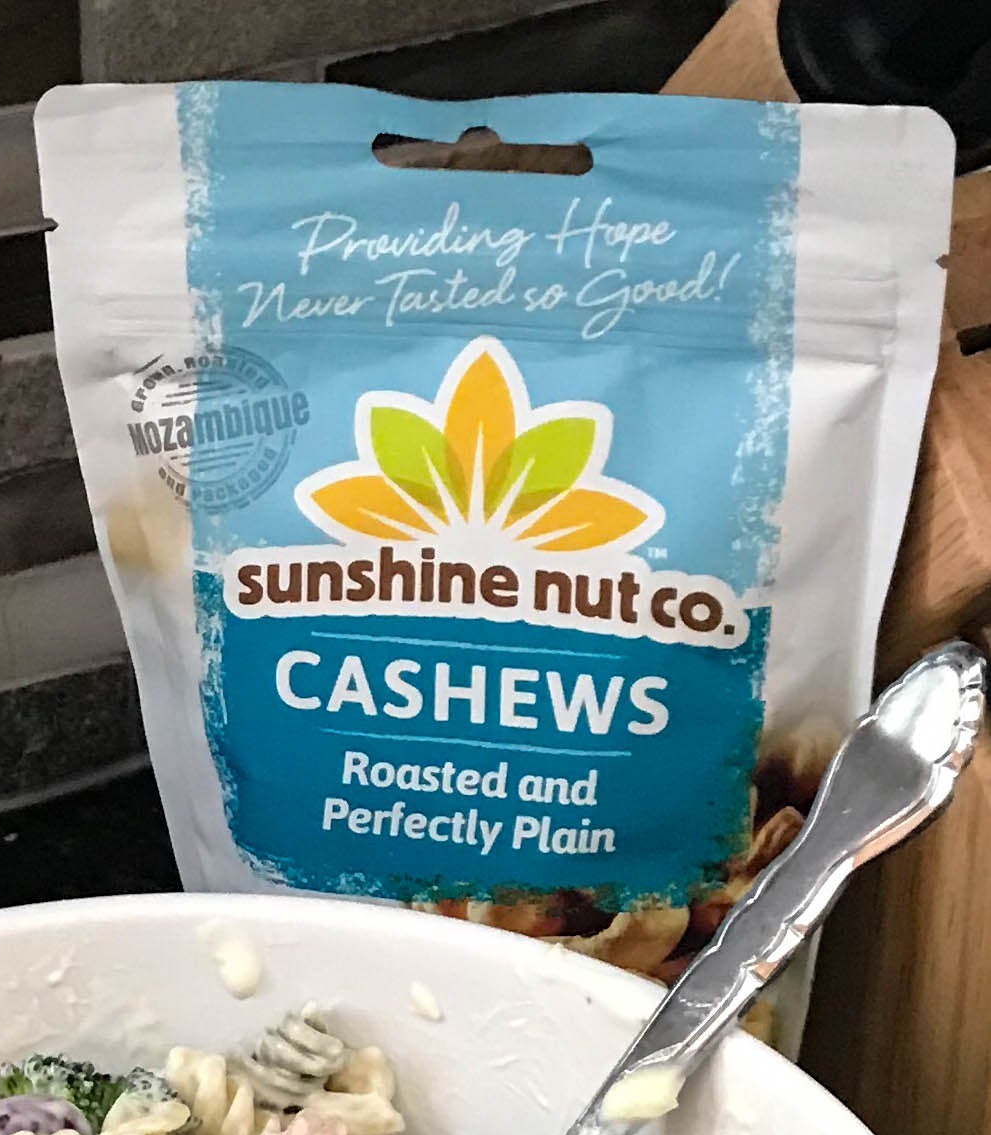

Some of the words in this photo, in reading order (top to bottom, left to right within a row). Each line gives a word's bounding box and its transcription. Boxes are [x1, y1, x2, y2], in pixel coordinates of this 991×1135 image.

[292, 202, 537, 275] Providing
[545, 197, 678, 269] Hope
[238, 281, 374, 328] Never
[374, 267, 517, 328] Tasted
[524, 284, 567, 312] so
[575, 252, 742, 340] Good!
[126, 390, 311, 457] Mozambique
[237, 546, 520, 606] sunshine
[534, 569, 641, 624] nut
[650, 586, 736, 636] co.
[274, 649, 670, 736] CASHEWS
[342, 750, 509, 799] Roasted
[518, 769, 599, 807] and
[321, 797, 503, 856] Perfectly
[511, 815, 617, 855] Plain
